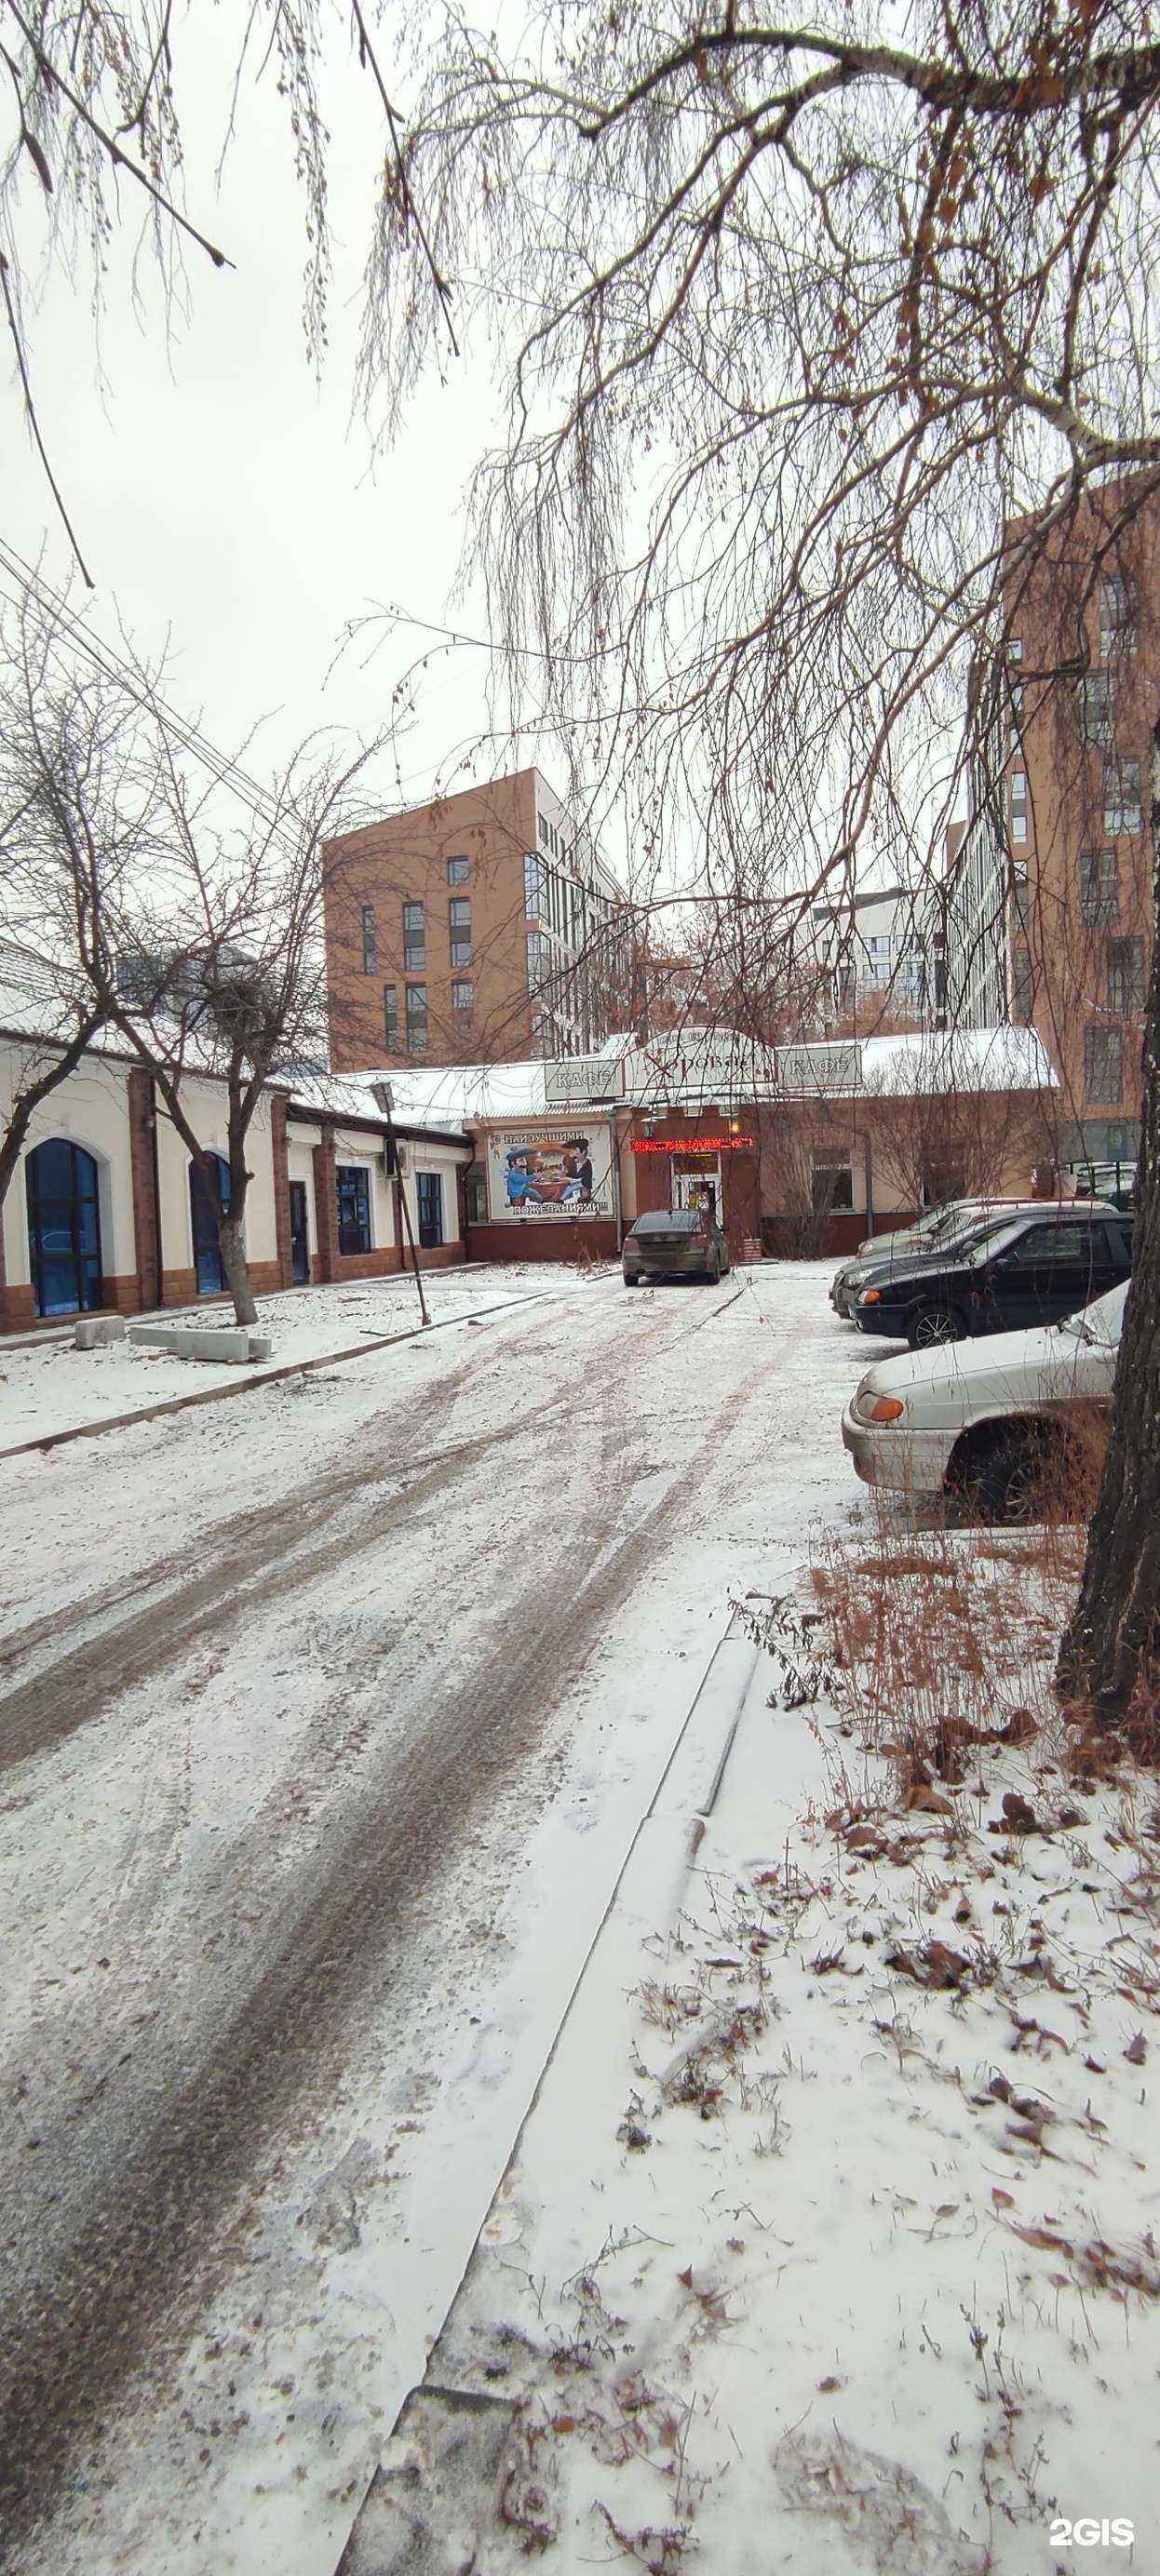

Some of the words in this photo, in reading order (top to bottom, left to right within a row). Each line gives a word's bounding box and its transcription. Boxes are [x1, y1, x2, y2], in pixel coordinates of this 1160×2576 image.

[789, 1057, 848, 1075] КАФЕ
[557, 1070, 611, 1089] КАФЕ
[492, 1135, 502, 1145] С
[504, 1131, 584, 1144] НАИЛУЧШИМИ
